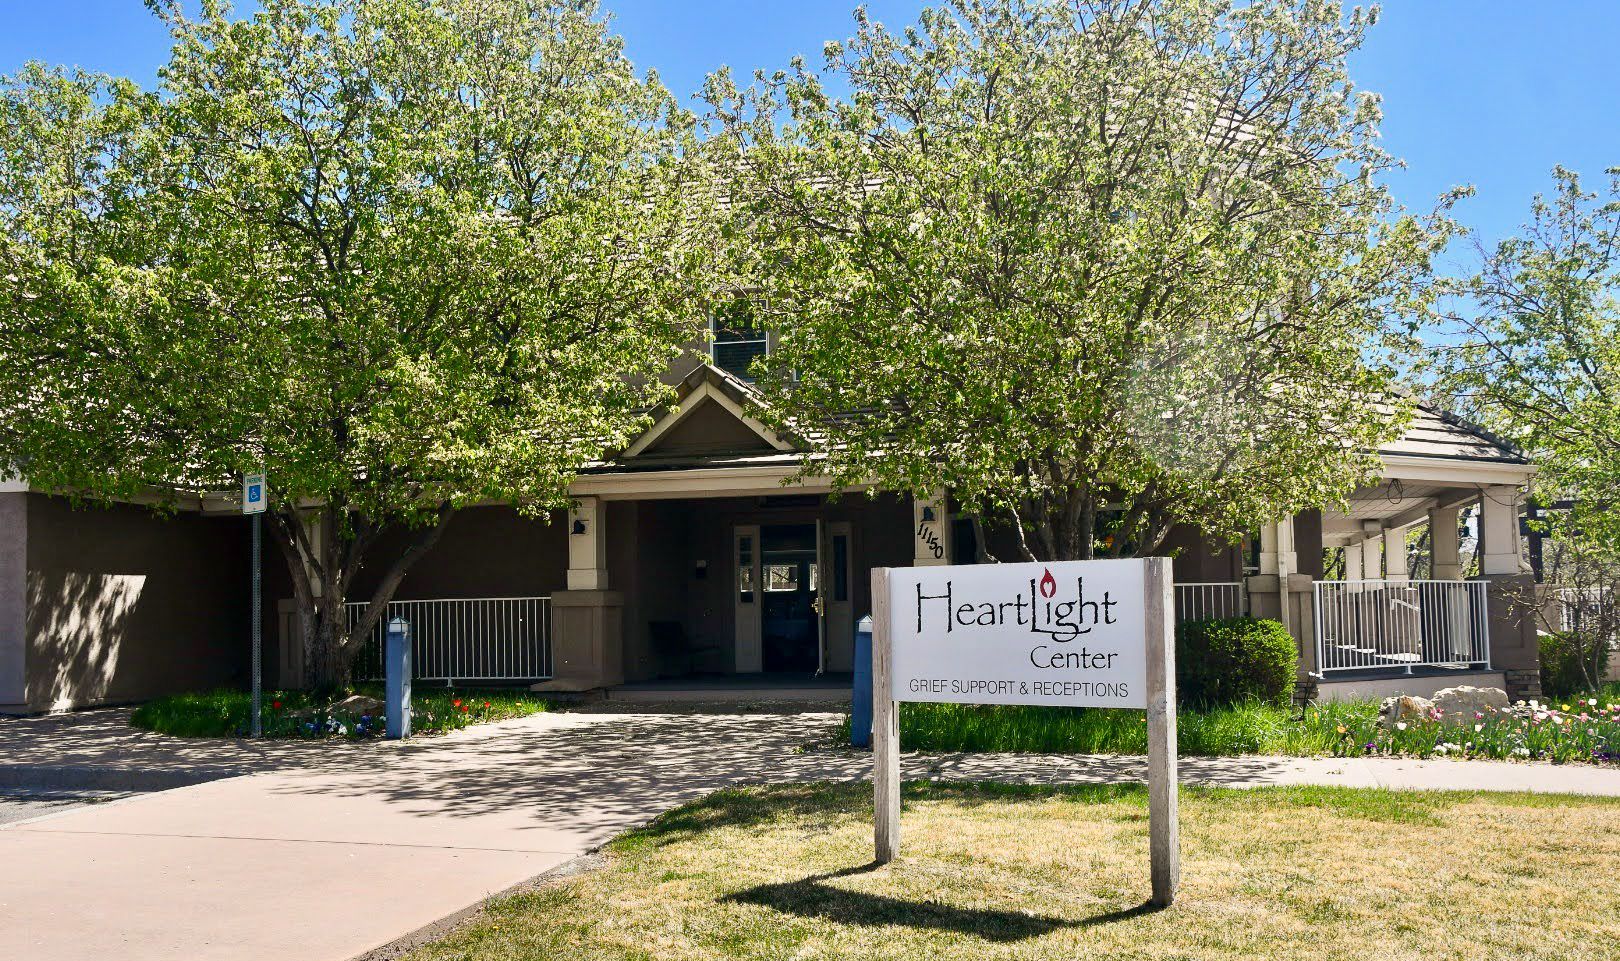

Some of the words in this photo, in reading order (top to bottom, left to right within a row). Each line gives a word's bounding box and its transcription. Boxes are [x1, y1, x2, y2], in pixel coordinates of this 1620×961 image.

[917, 523, 943, 559] 11150
[916, 576, 1118, 643] HeartLight
[1030, 646, 1118, 669] Center
[909, 678, 948, 694] GRIEF
[952, 680, 1016, 696] SUPPORT
[1019, 682, 1029, 696] &
[1033, 682, 1129, 698] RECEPTIONS
